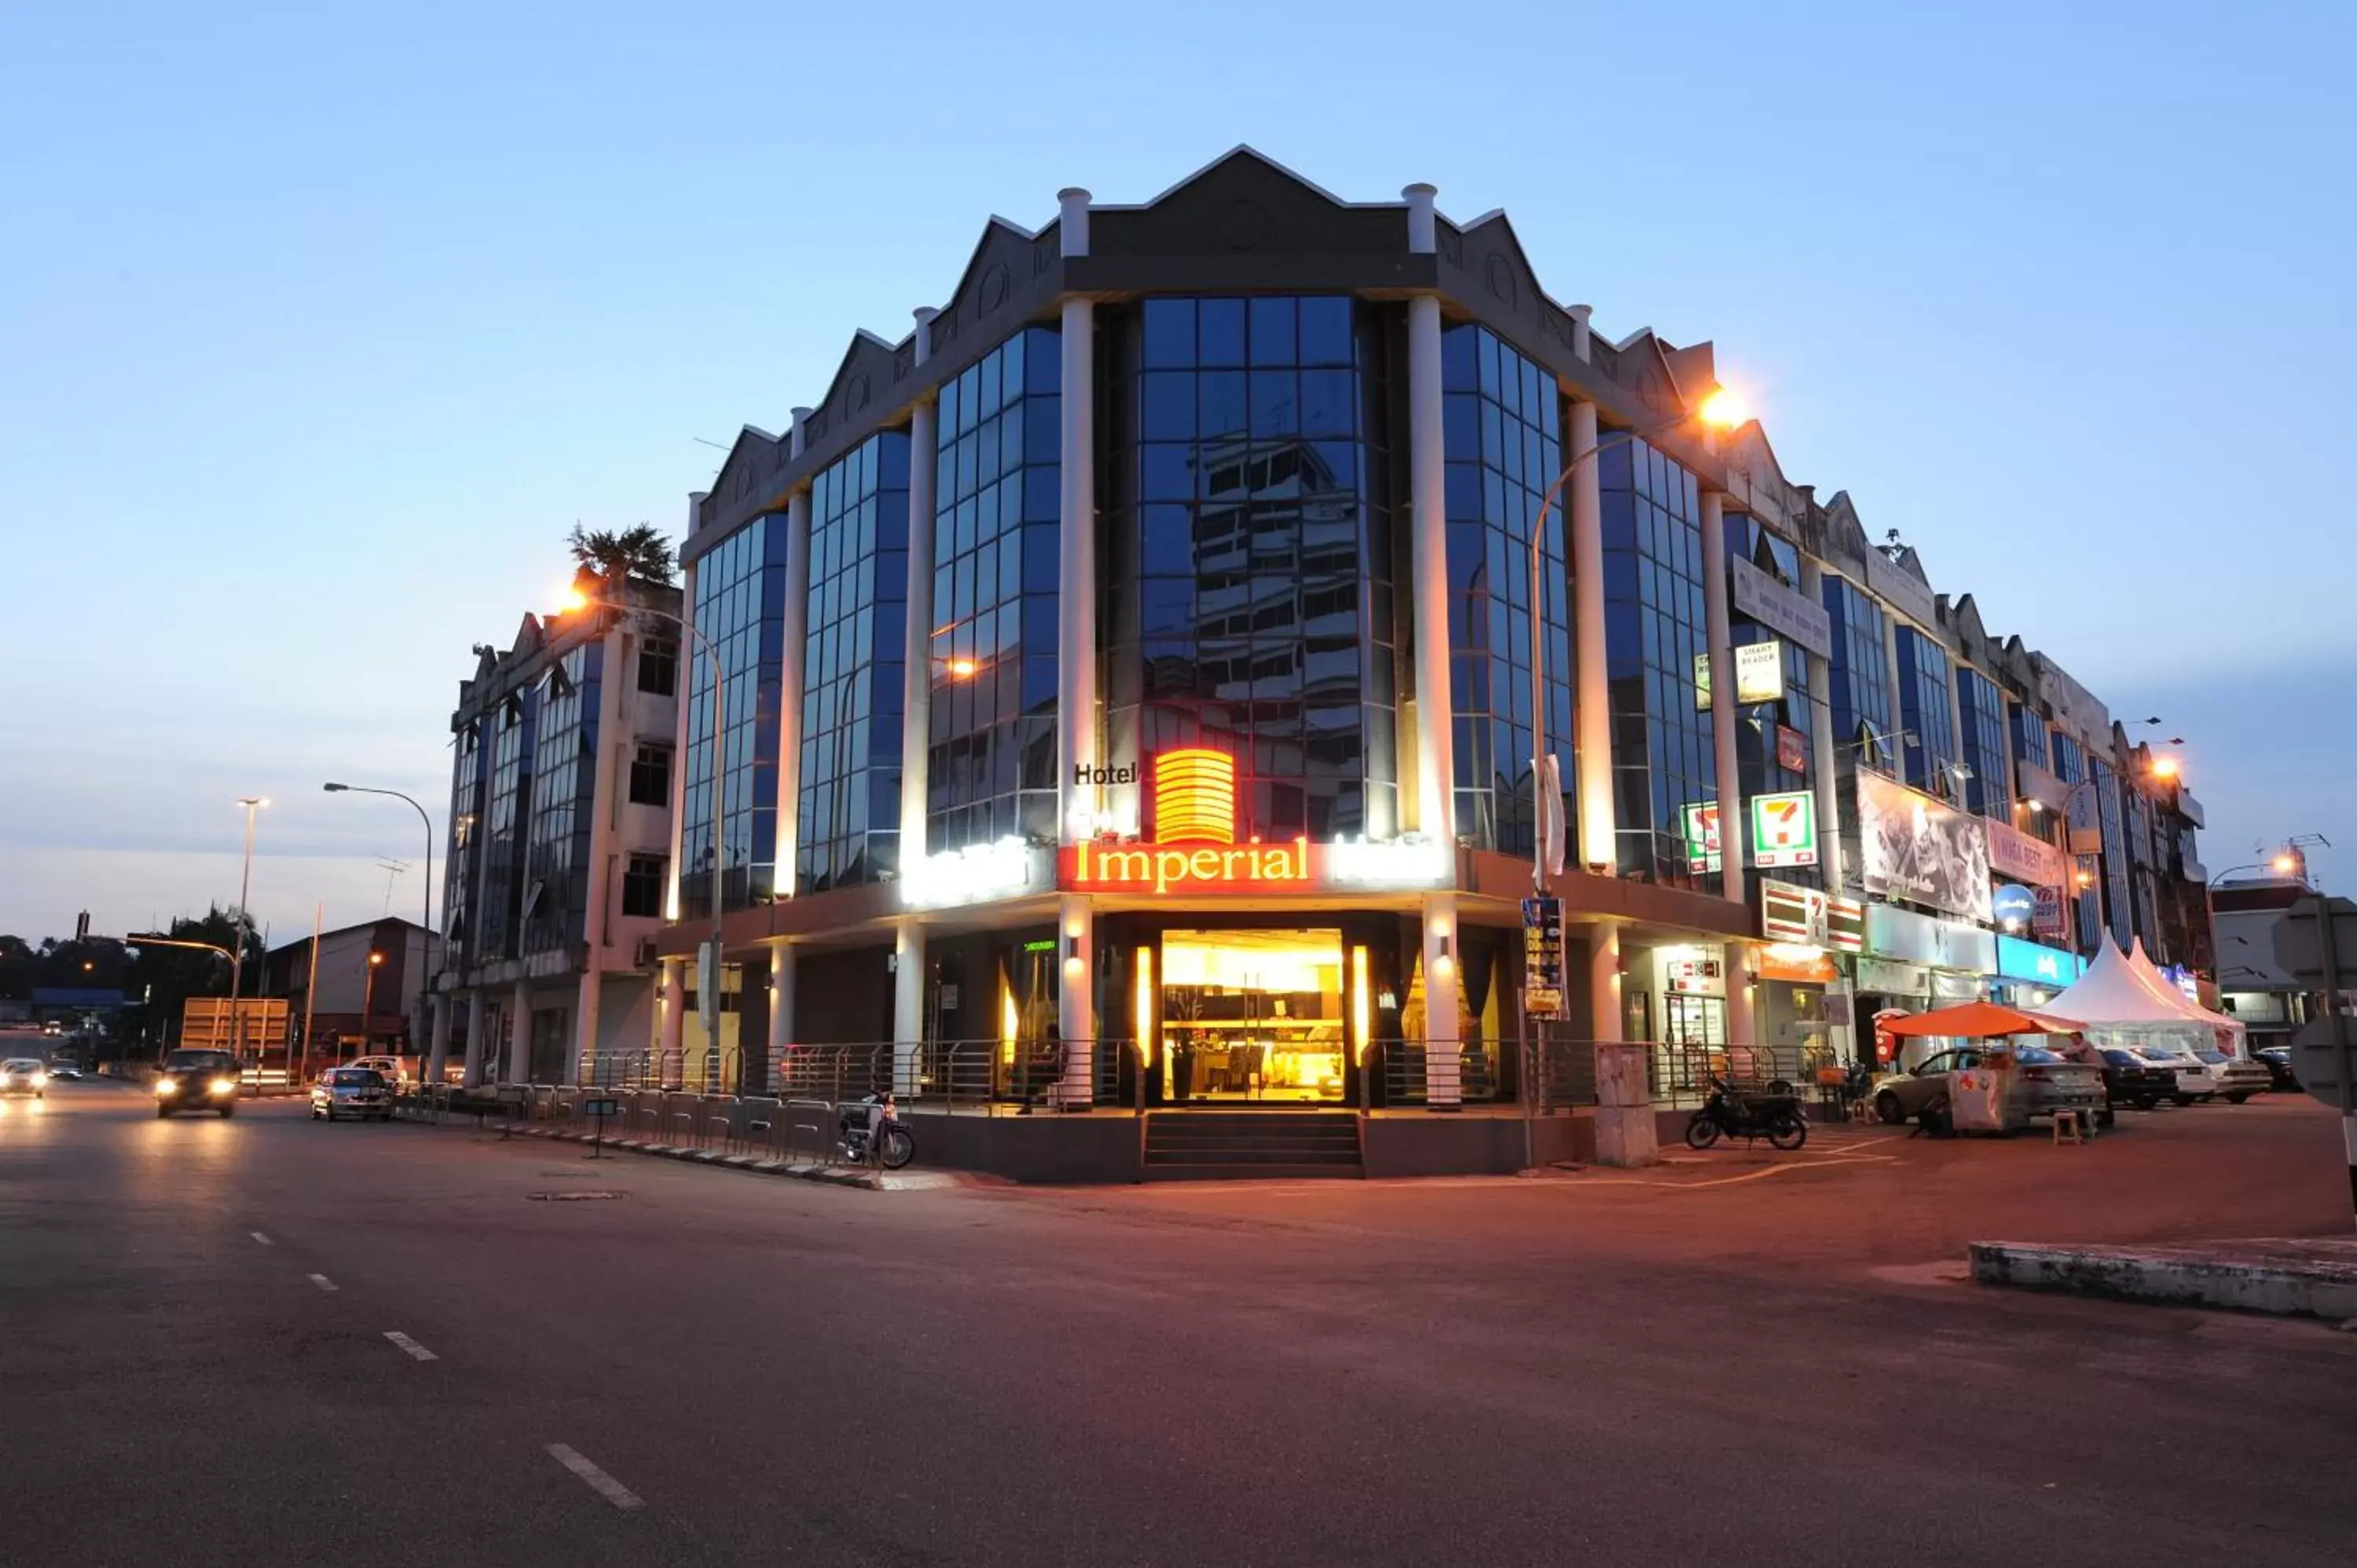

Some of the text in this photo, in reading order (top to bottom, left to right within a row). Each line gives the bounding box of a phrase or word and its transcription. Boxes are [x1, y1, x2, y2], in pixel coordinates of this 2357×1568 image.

[1742, 654, 1775, 665] READER
[1075, 762, 1136, 785] Hotel
[1076, 836, 1309, 894] Imperial
